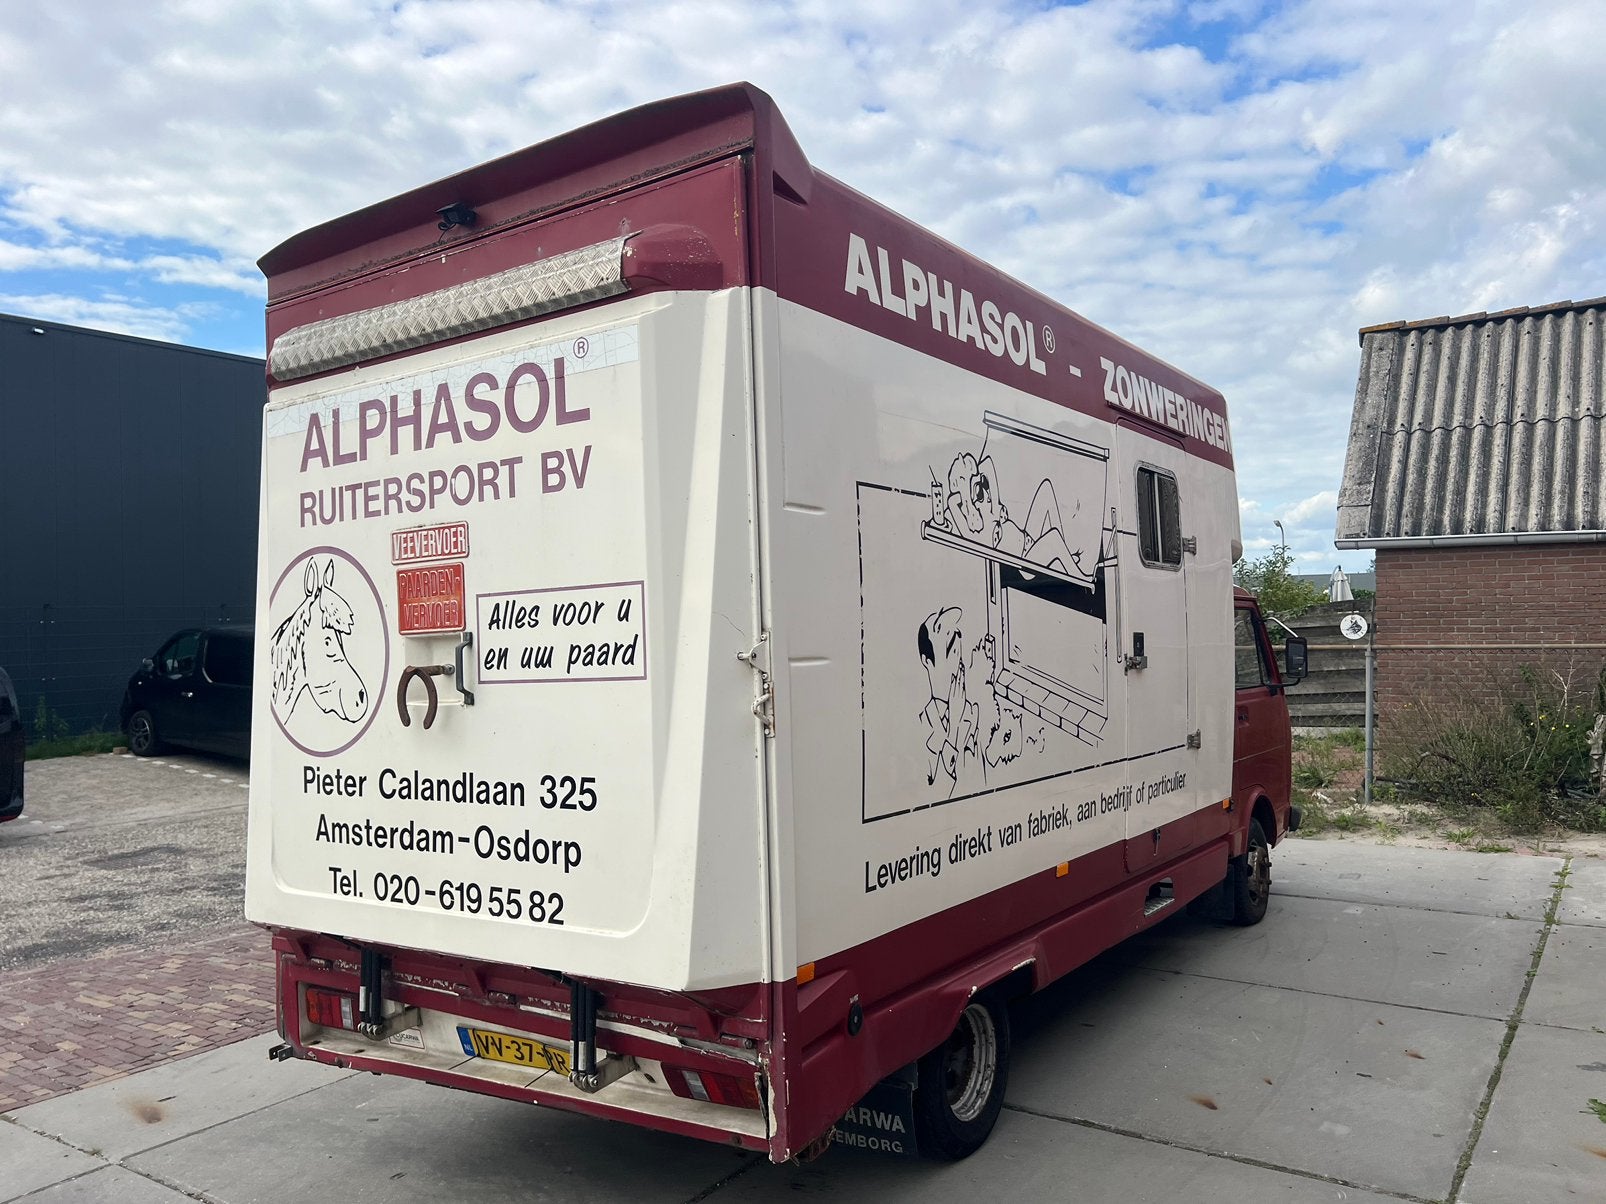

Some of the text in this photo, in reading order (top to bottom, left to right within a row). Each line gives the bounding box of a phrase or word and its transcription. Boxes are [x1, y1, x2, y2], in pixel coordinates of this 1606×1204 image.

[844, 232, 1047, 375] ALPHASOL
[1100, 356, 1232, 455] ZONWERINGEN
[300, 357, 590, 473] ALPHASOL
[300, 445, 592, 527] RUITERSPORT BV
[392, 527, 466, 560] VEEVERVOER
[404, 600, 459, 628] VERVOER
[488, 599, 632, 630] Alles voor u
[484, 634, 639, 674] en uw paard
[303, 766, 597, 811] Pieter Calandlaan 325
[315, 814, 582, 873] Amsterdam-Osdorp
[865, 771, 1186, 893] Levering direkt van fabriek, aan bedrijf of particulier
[329, 867, 363, 898] Tel.
[844, 1107, 906, 1134] ARWA
[831, 1129, 903, 1153] EMBORG
